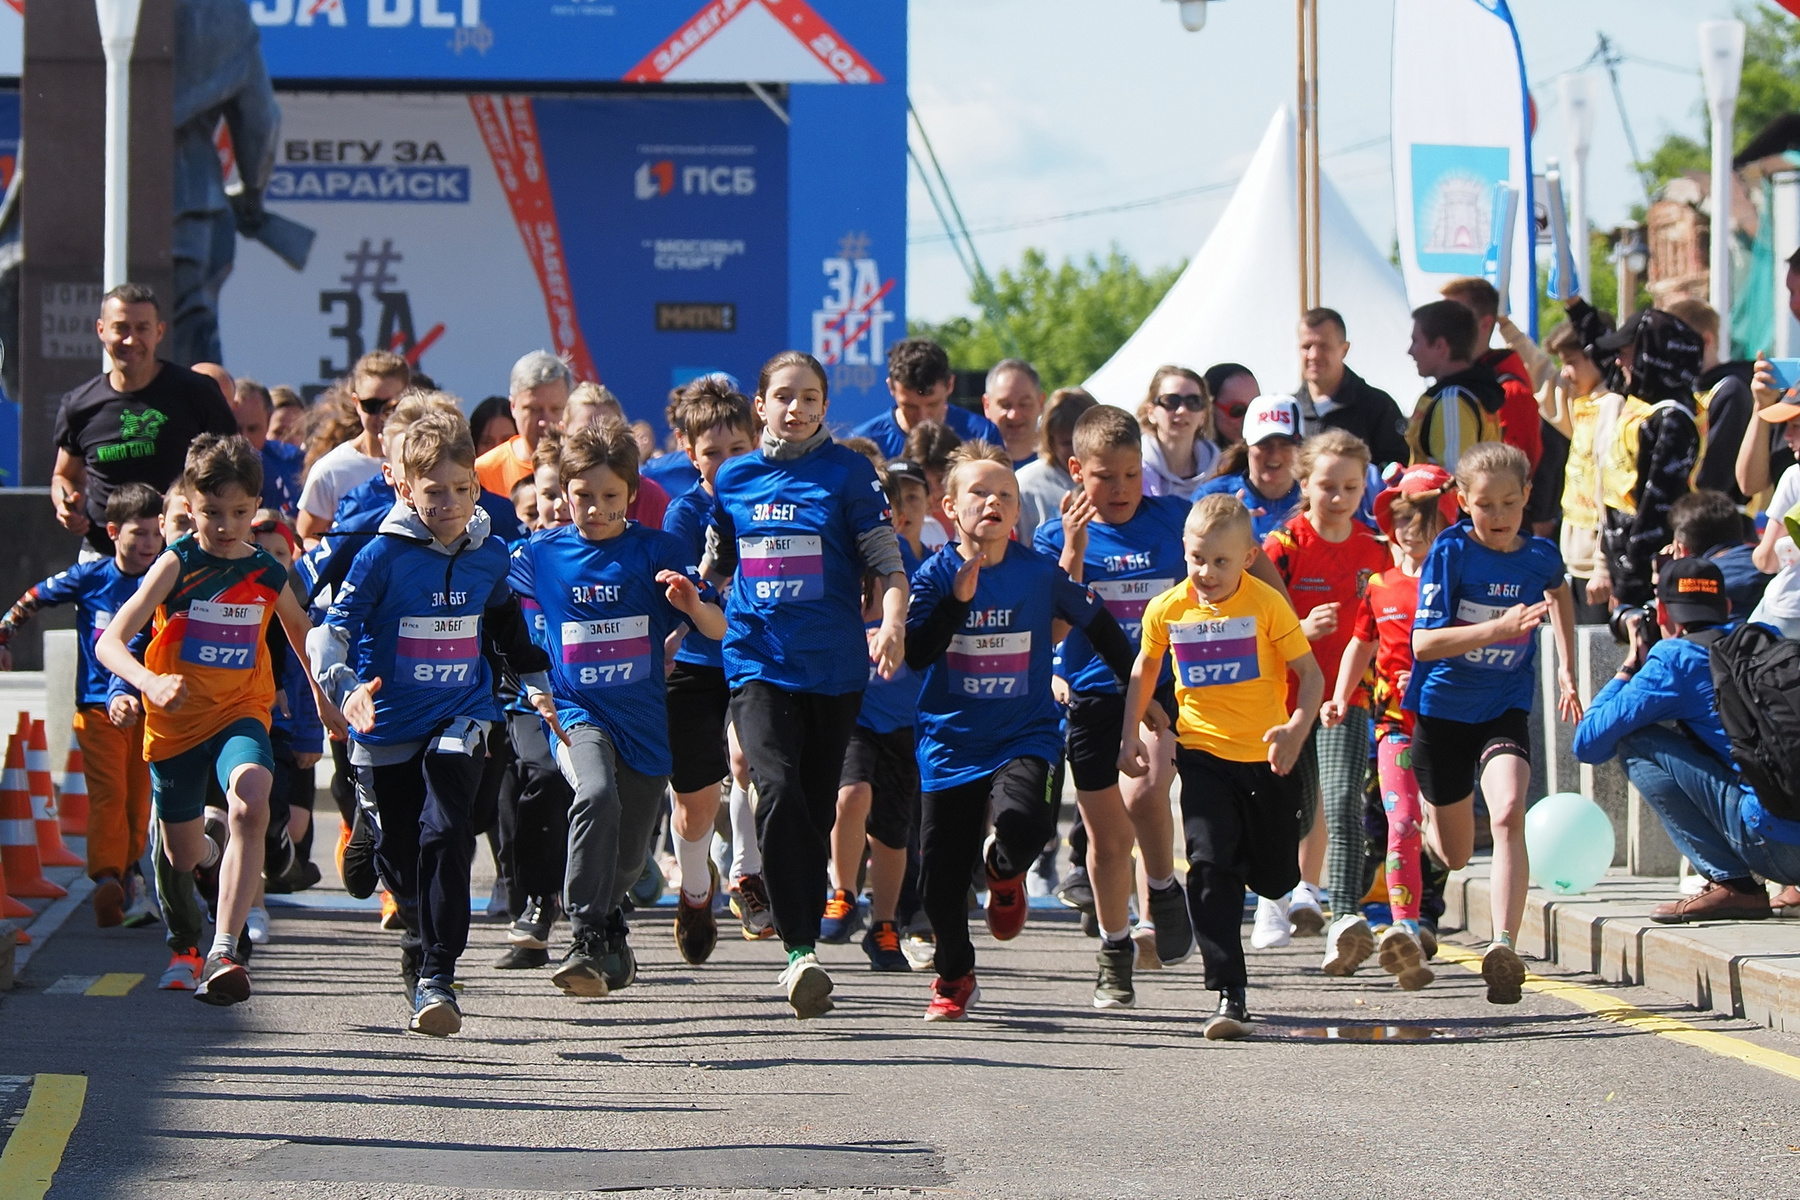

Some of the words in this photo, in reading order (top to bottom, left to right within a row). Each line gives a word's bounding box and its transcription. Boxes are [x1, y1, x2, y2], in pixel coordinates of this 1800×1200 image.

[285, 140, 382, 162] БЕГУ
[394, 140, 446, 162] ЗА
[270, 167, 462, 198] ЗАРАЙСК
[683, 165, 757, 195] ПСБ
[536, 221, 576, 349] ЗАБЕГ.РФ
[822, 257, 885, 312] ЗА
[318, 290, 422, 380] ЗА
[1258, 410, 1291, 425] RUS
[755, 579, 803, 599] 877
[198, 645, 249, 665] 877
[1463, 647, 1516, 667] 877
[413, 663, 469, 682] 877
[579, 662, 634, 685] 877
[1188, 661, 1241, 684] 877
[963, 677, 1016, 695] 877
